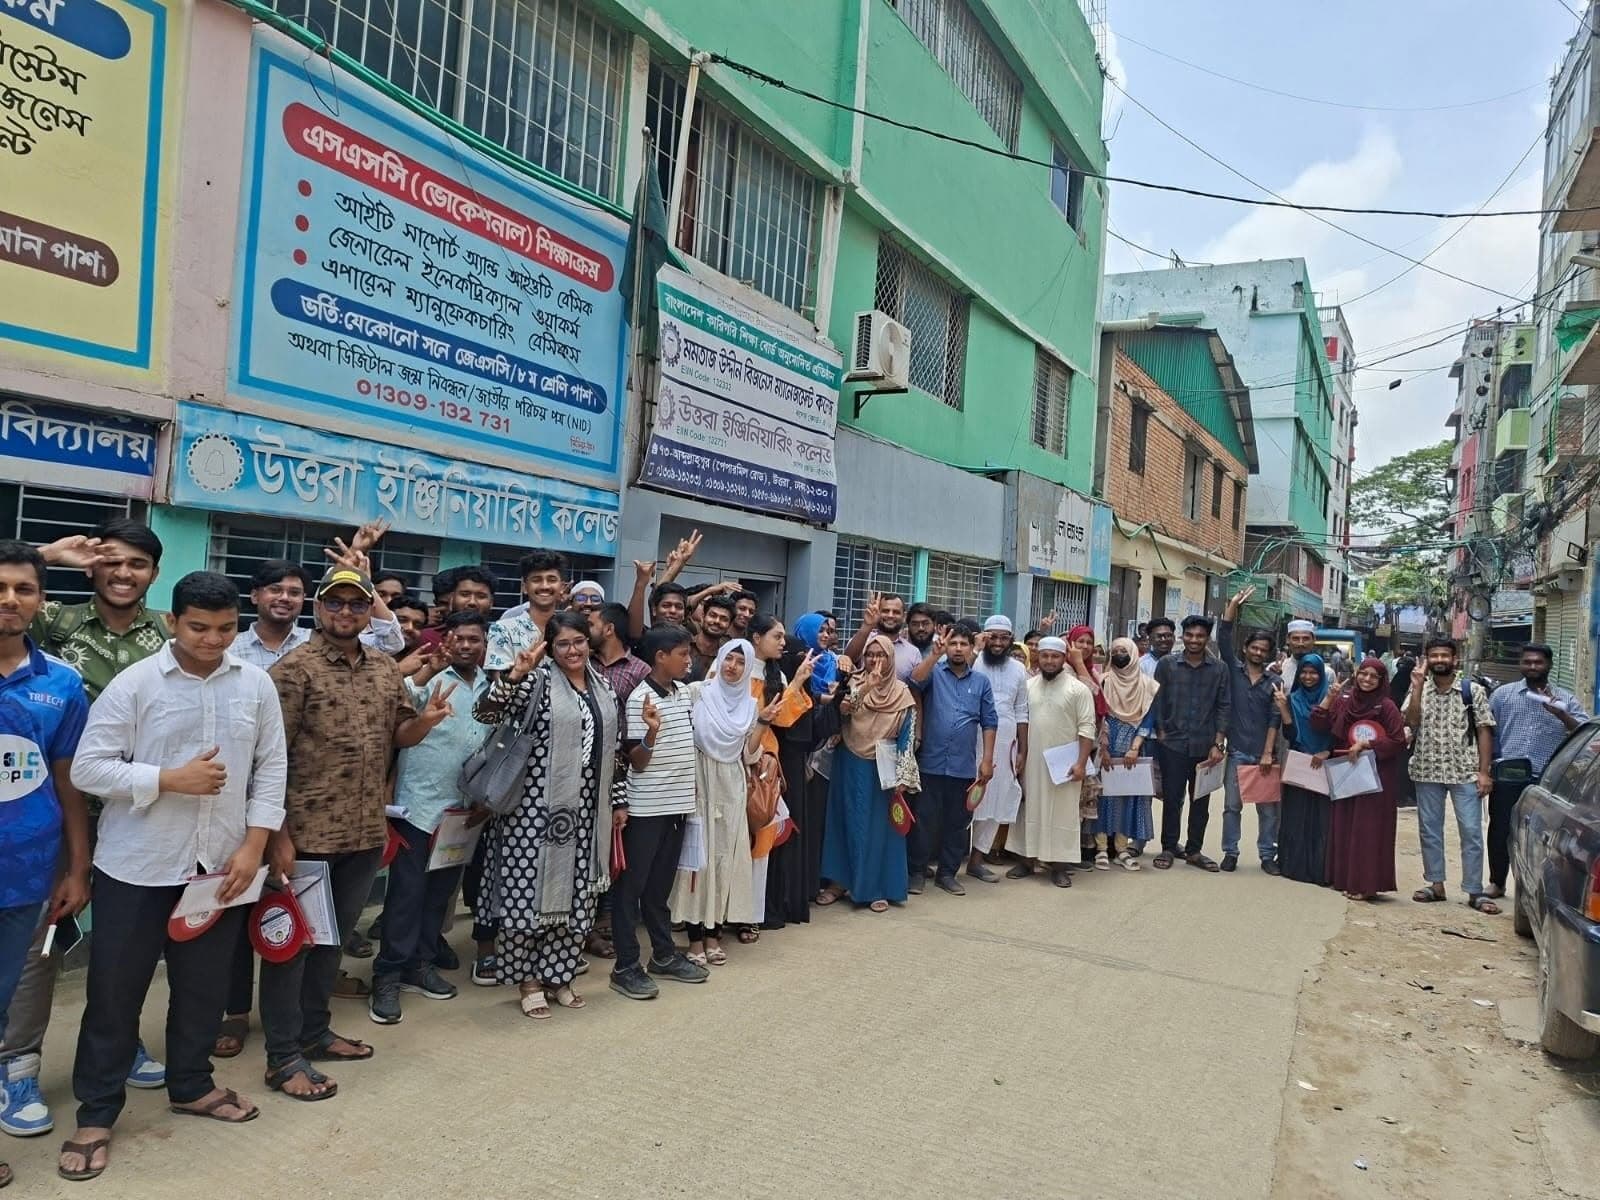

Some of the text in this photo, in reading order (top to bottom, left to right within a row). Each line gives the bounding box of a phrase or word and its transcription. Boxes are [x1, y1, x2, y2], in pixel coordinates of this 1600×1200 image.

[302, 126, 408, 191] এসএসসি
[329, 228, 413, 272] জেনারেল
[335, 192, 395, 232] আইটি
[403, 222, 460, 259] সাপোর্ট
[558, 289, 593, 316] বেসিক
[322, 259, 396, 297] এপারেল
[422, 334, 451, 361] সনে
[683, 338, 718, 371] মমতাজ
[288, 332, 336, 361] অথবা
[337, 340, 395, 376] ডিজিটাল
[399, 364, 425, 386] জন্ম
[515, 397, 549, 421] পরিচয়
[357, 379, 511, 433] 01309-132 731
[678, 395, 719, 436] উত্তরা
[250, 425, 364, 511] উত্তরা
[374, 451, 542, 542] ইঞ্জিনিয়ারিং
